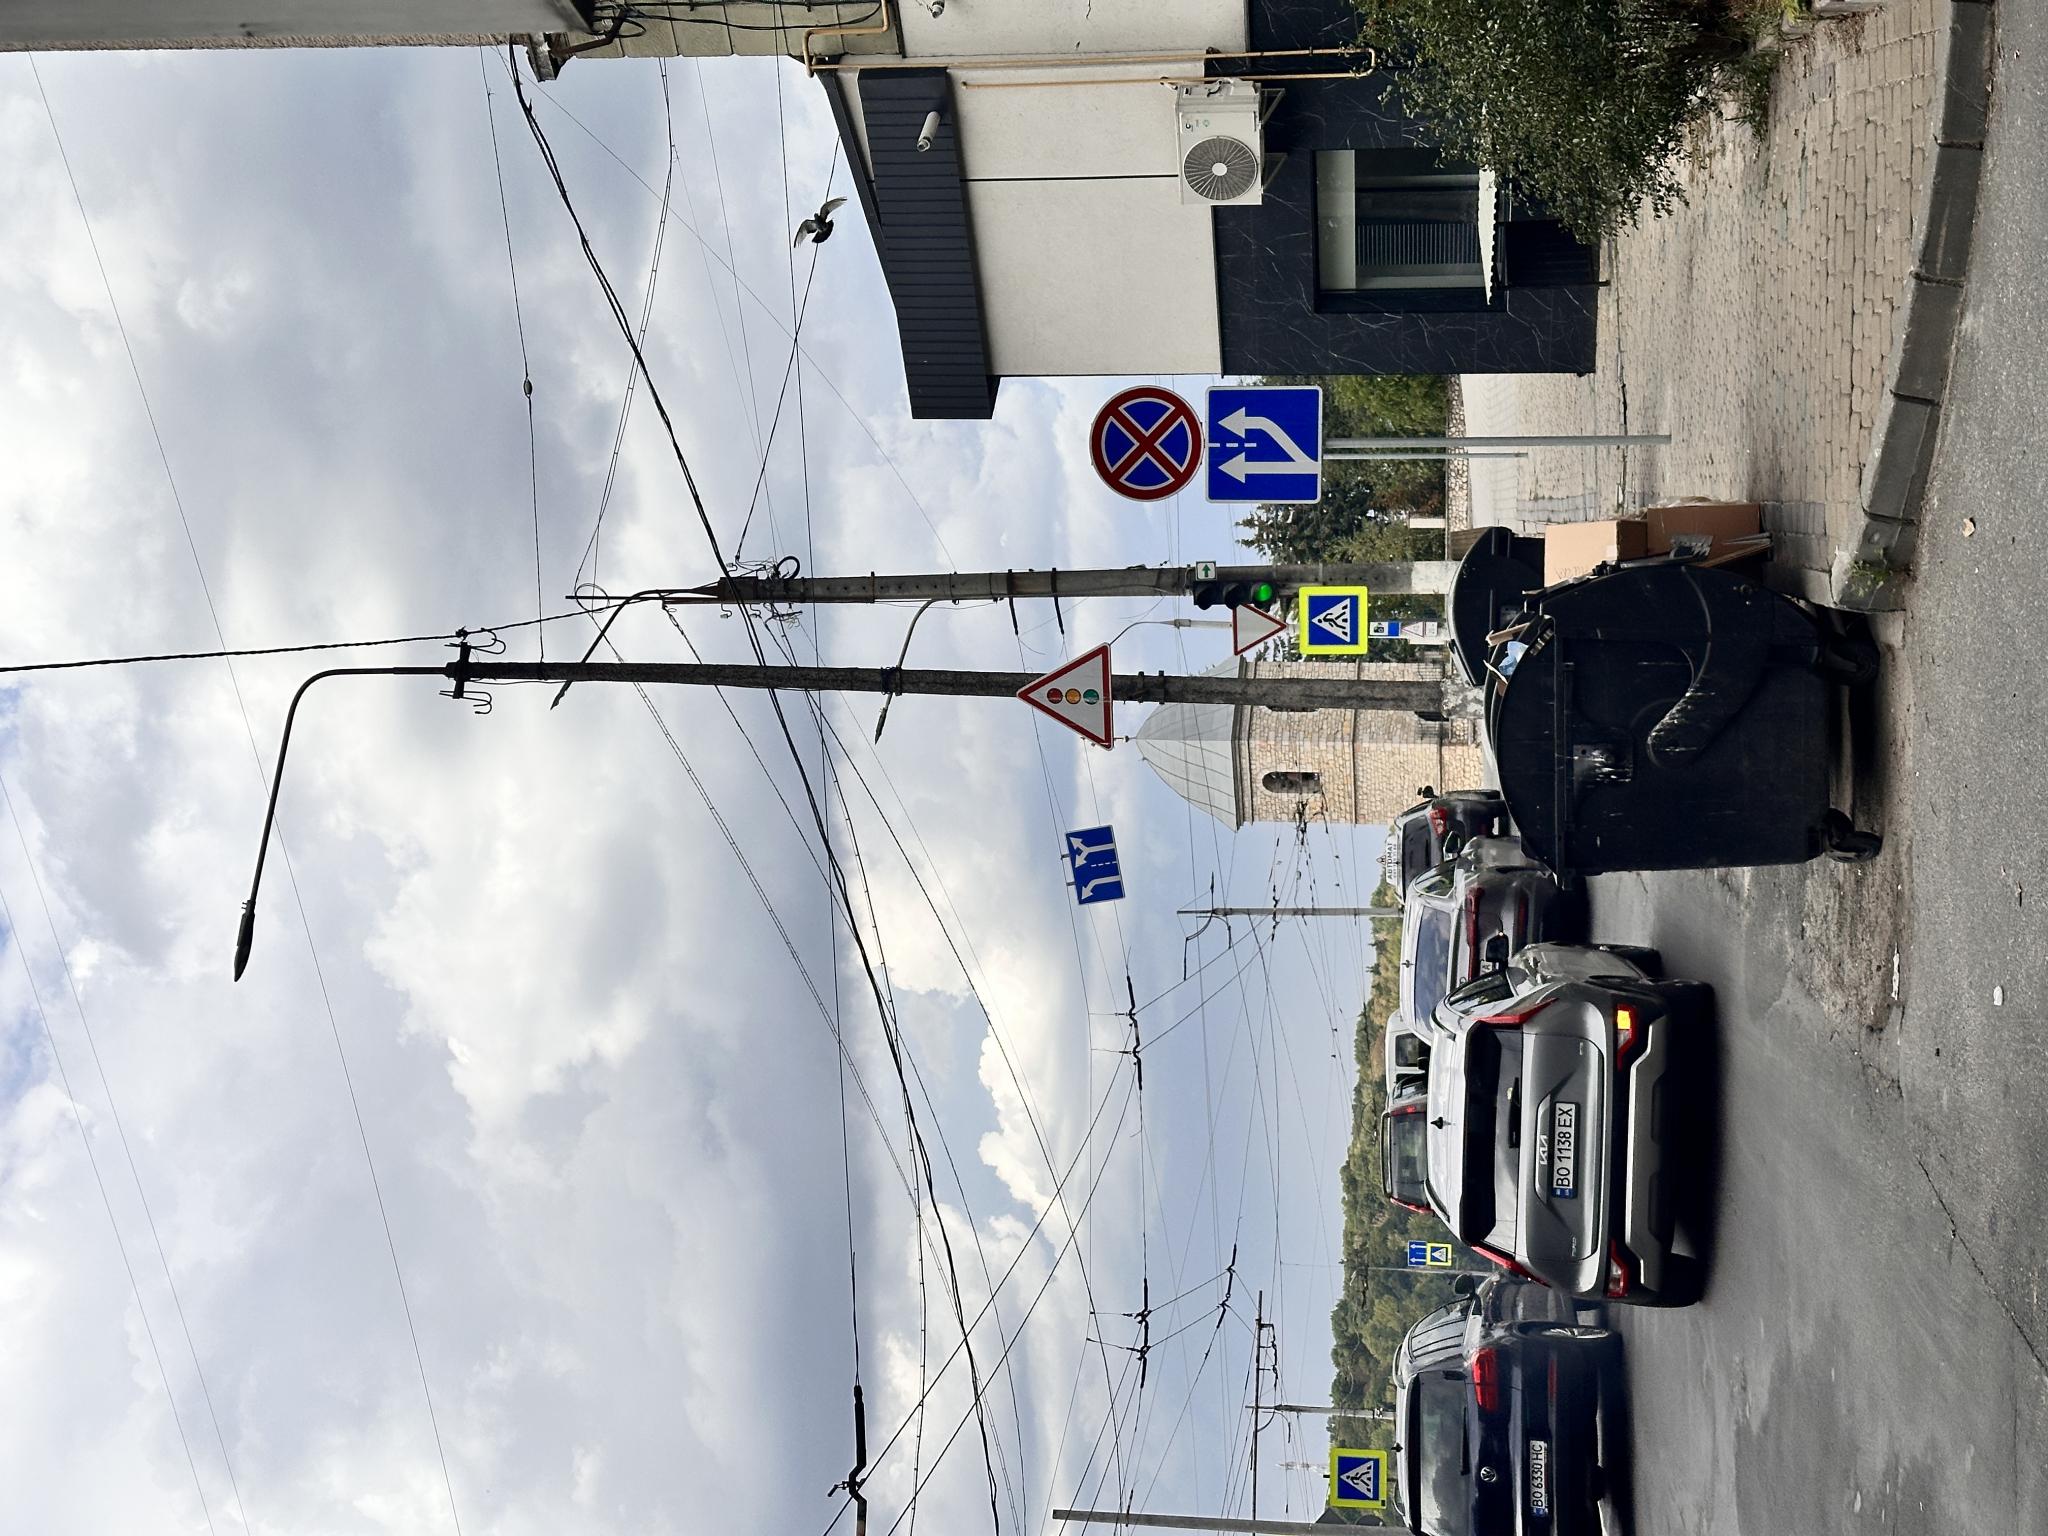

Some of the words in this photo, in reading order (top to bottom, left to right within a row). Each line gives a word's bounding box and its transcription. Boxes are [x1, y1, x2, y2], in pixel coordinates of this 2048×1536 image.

[1558, 1107, 1572, 1128] EX
[1557, 1131, 1571, 1162] 1138
[1556, 1167, 1570, 1187] BO
[1532, 1444, 1543, 1460] HC
[1532, 1463, 1543, 1489] 6330
[1532, 1491, 1543, 1507] BO
